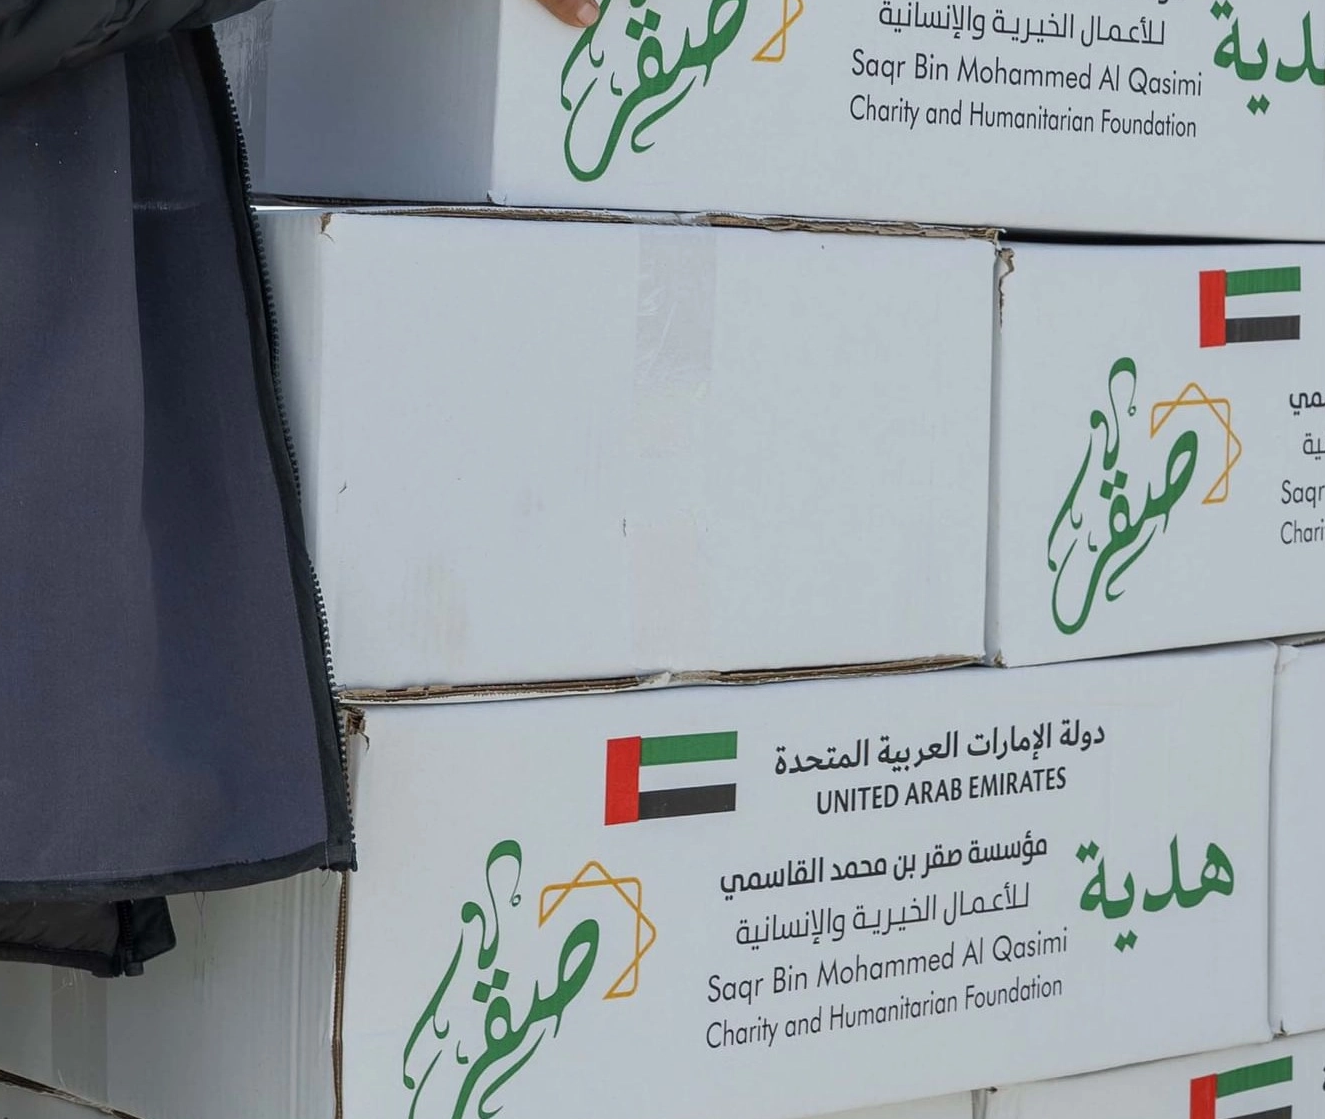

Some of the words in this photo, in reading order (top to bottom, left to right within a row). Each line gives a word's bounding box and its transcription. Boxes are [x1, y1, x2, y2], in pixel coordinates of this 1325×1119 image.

[879, 1, 985, 41] والإنسانية
[992, 10, 1074, 44] الخيرية
[1080, 15, 1165, 48] للأعمال
[851, 49, 907, 85] Saqr
[915, 53, 948, 82] Bin
[958, 56, 1092, 90] Mohammed
[1099, 65, 1120, 91] Al
[1128, 67, 1202, 96] Qasimi
[850, 95, 920, 131] Charity
[926, 100, 963, 126] and
[970, 102, 1094, 132] Humanitarian
[1101, 109, 1196, 137] Foundation
[1281, 479, 1325, 508] Saqr
[878, 730, 959, 772] العربية
[967, 722, 1052, 761] الإمارات
[1059, 719, 1106, 752] دولة
[775, 739, 869, 776] المتحدة
[816, 784, 899, 815] UNITED
[904, 777, 963, 806] ARAB
[969, 766, 1066, 799] EMIRATES
[892, 854, 916, 881] بن
[920, 844, 963, 879] صقر
[968, 830, 1048, 866] مؤسسة
[720, 856, 824, 901] القاسمي
[830, 857, 887, 881] محمد
[943, 882, 1029, 926] للأعمال
[1075, 833, 1234, 953] هدية
[736, 907, 845, 951] والإنسانية
[852, 894, 936, 935] الخيرية
[708, 974, 765, 1005] Saqr
[774, 965, 808, 995] Bin
[817, 941, 955, 988] Mohammed
[962, 937, 983, 967] Al
[992, 927, 1068, 963] Qasimi
[706, 1016, 779, 1049] Charity
[785, 1006, 823, 1038] and
[830, 991, 957, 1031] Humanitarian
[965, 976, 1062, 1010] Foundation
